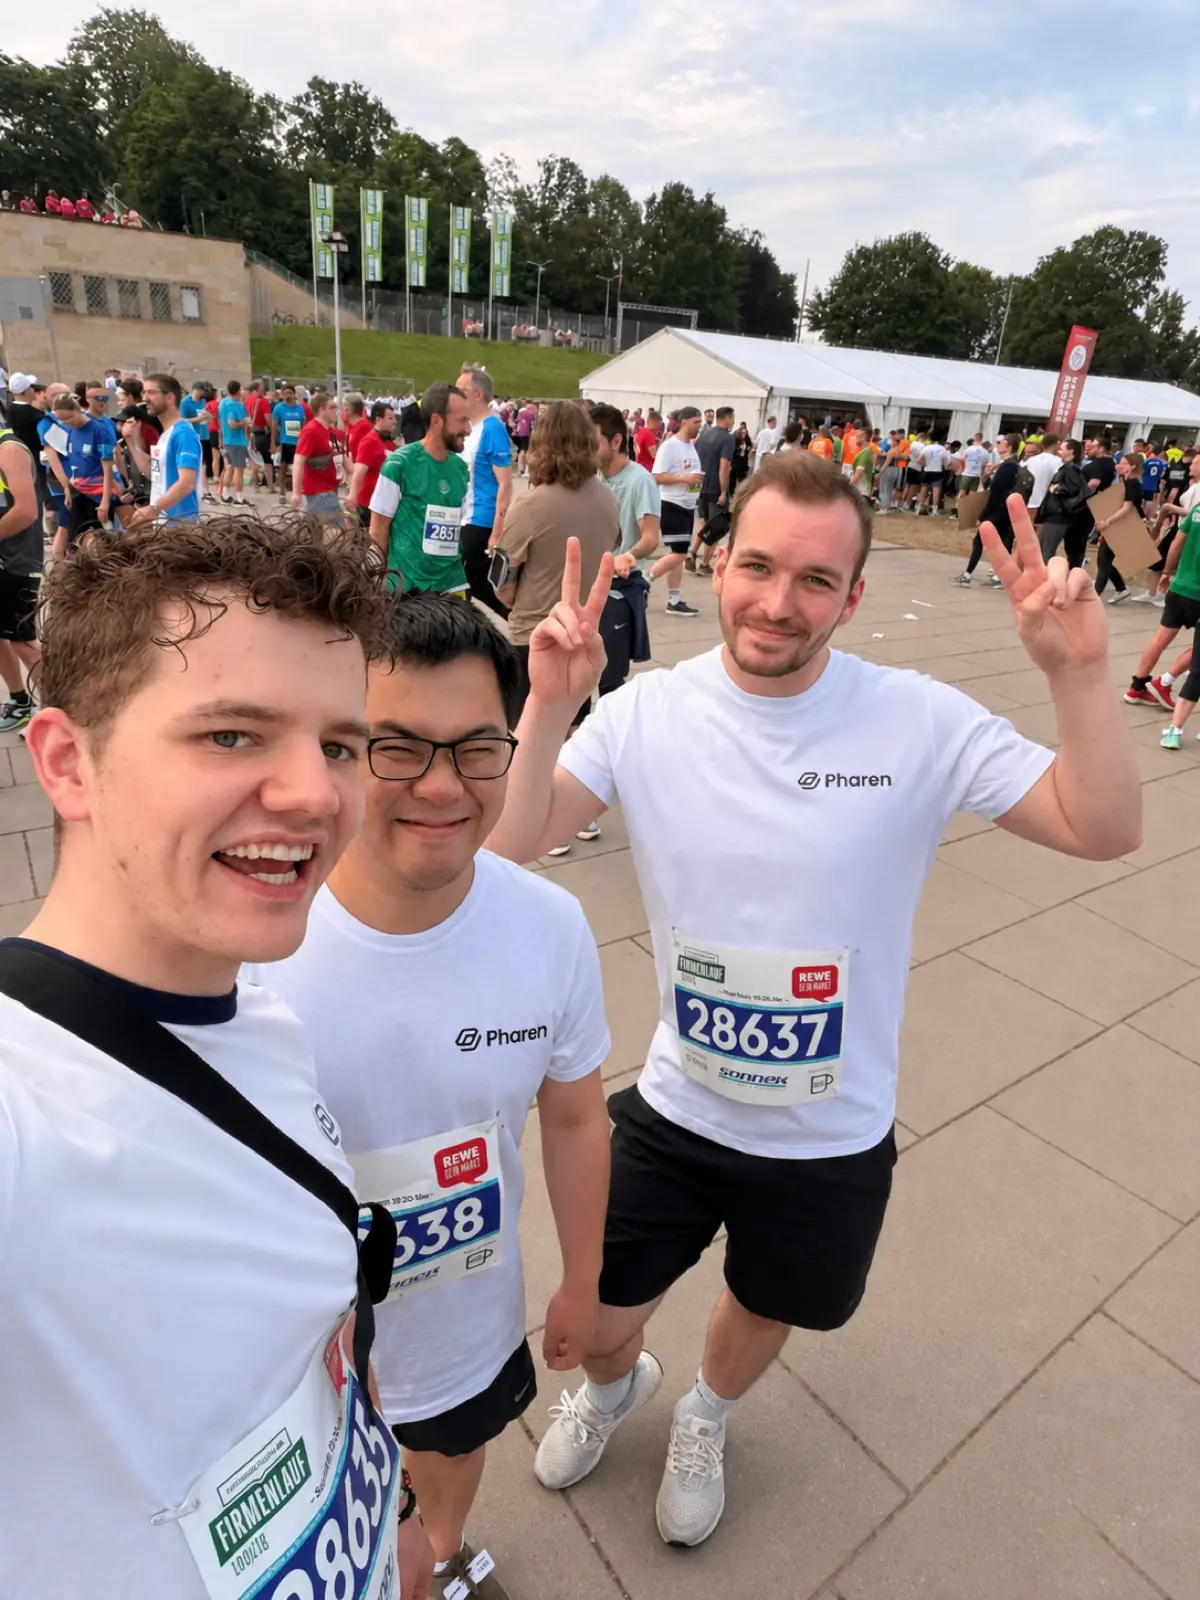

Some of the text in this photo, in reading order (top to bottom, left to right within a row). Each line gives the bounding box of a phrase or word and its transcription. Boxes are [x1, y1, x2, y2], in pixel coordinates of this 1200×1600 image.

[825, 773, 892, 788] Pharen
[799, 971, 832, 982] REWE
[486, 1025, 547, 1047] Pharen
[687, 998, 829, 1060] 28637
[443, 1146, 479, 1169] REWE
[358, 1198, 484, 1267] 638
[215, 1448, 306, 1552] FIRMENLAUF
